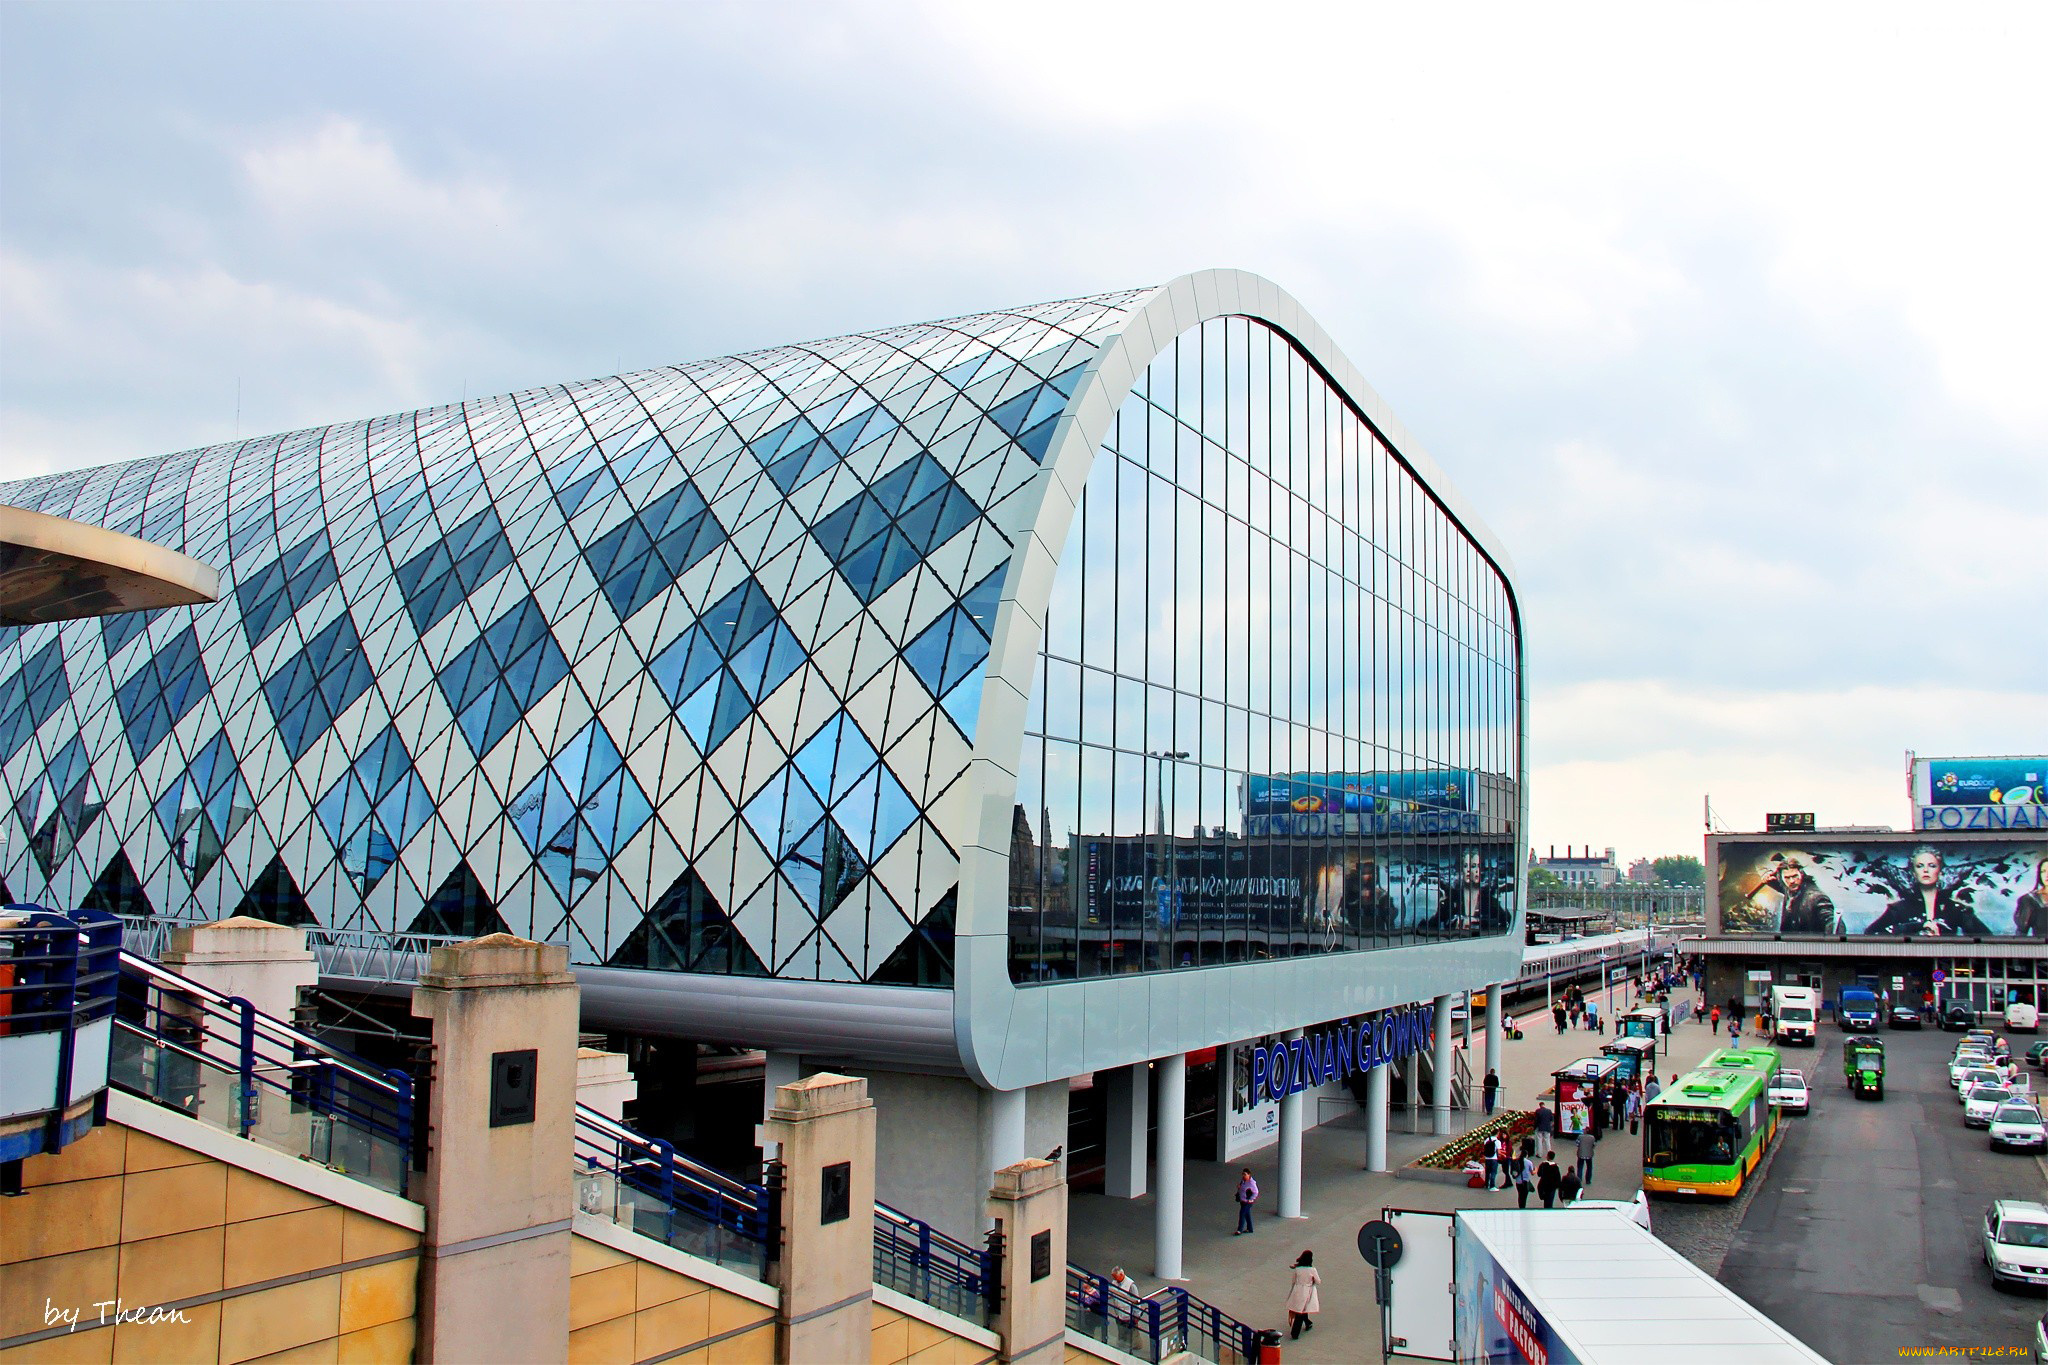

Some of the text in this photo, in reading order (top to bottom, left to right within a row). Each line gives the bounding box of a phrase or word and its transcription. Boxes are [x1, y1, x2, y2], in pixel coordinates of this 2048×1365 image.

[1773, 814, 1811, 824] 12:29
[1253, 1005, 1433, 1107] POZNAŃ GŁÓWNY
